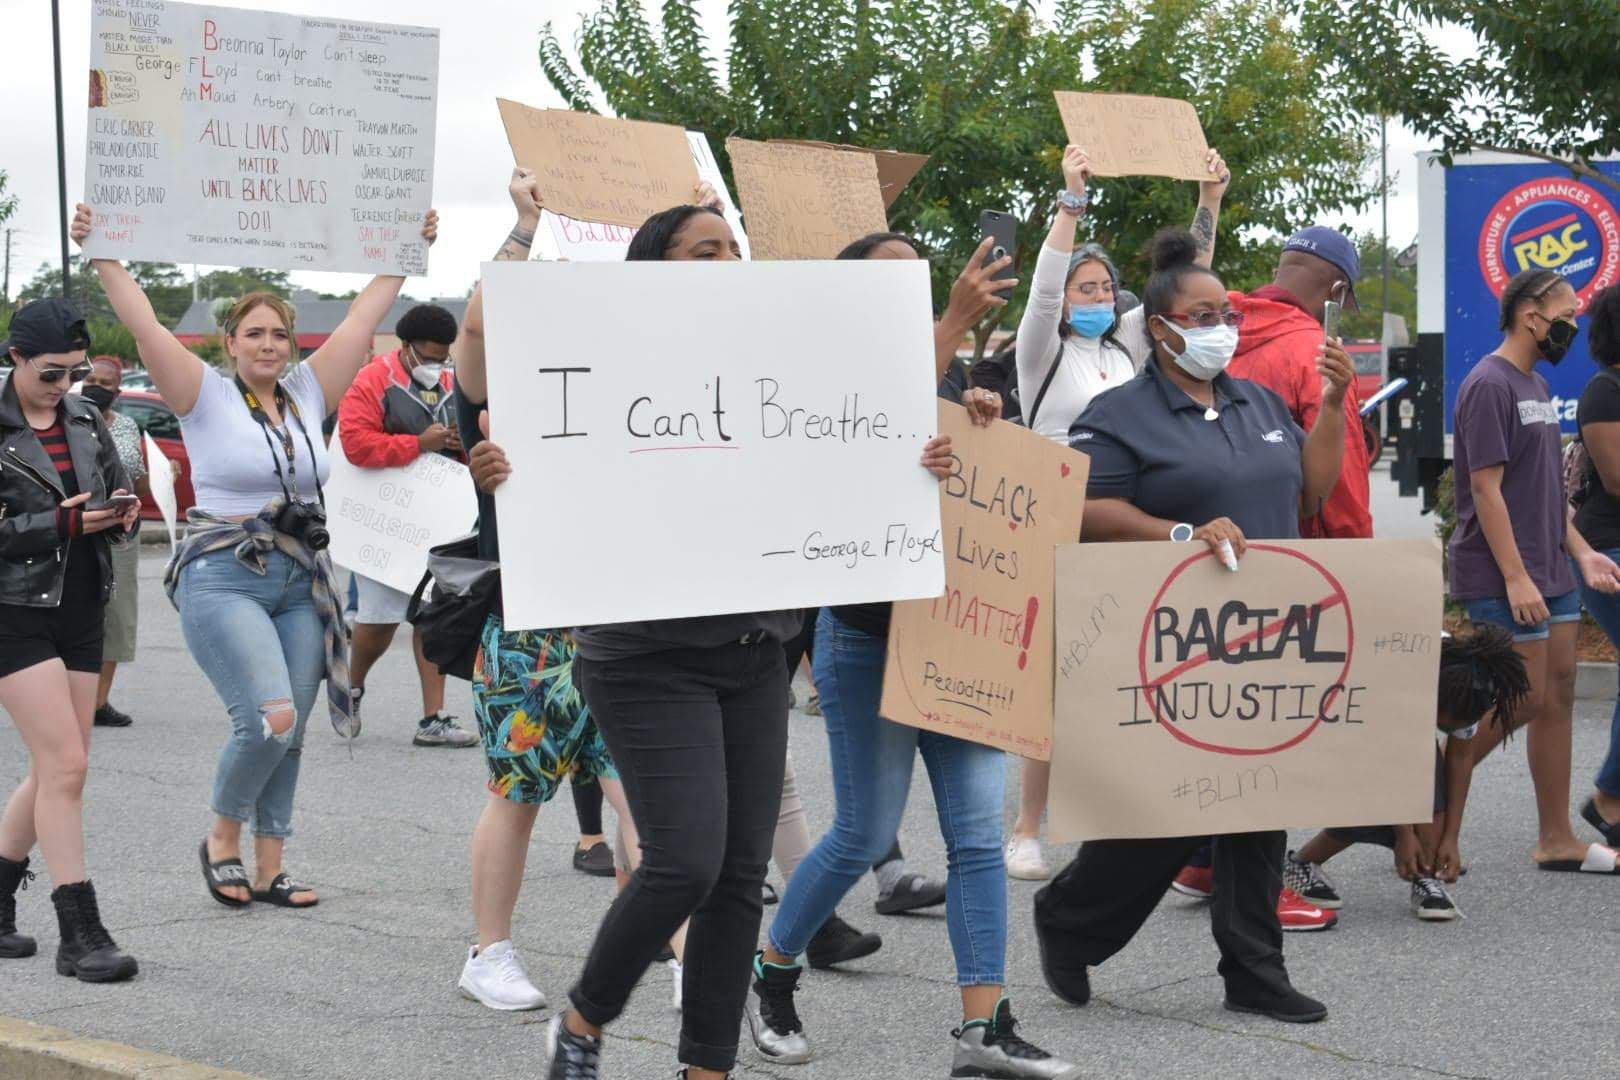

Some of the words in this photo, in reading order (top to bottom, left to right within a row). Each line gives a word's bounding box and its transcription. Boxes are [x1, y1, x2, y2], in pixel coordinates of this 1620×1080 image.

[97, 7, 127, 18] SHOULD
[128, 11, 160, 28] NEVER
[104, 41, 131, 52] BLACK
[203, 19, 264, 57] Breonna
[266, 36, 308, 67] Taylor
[358, 49, 388, 66] sleep
[135, 56, 181, 80] George
[293, 73, 334, 90] breathe
[252, 92, 297, 117] Arbery
[94, 117, 118, 135] ERIC
[120, 118, 155, 138] GARNER
[199, 119, 238, 148] ALL
[244, 122, 289, 155] LIVES
[238, 156, 280, 175] MATTER
[352, 142, 381, 159] WALTER
[384, 145, 414, 161] SCOTT
[96, 164, 125, 178] TAMIR
[126, 164, 145, 179] RICE
[91, 183, 132, 206] SANDRA
[134, 184, 167, 207] BLAND
[201, 178, 234, 199] UNTIL
[241, 177, 286, 205] BLACK
[287, 178, 328, 205] LIVES
[355, 184, 383, 200] OSCAR
[384, 186, 412, 201] GRANT
[1514, 183, 1592, 206] APPLIANCES
[1485, 213, 1507, 283] FURNITURE
[1513, 222, 1588, 272] RAC
[1593, 210, 1619, 291] ELECTRONICS
[538, 367, 591, 439] I
[627, 375, 732, 442] Can't
[755, 377, 934, 444] Breathe...
[378, 482, 415, 509] NO
[944, 454, 1038, 528] BLACK
[338, 497, 430, 546] JUSTICE
[358, 543, 392, 569] NO
[802, 531, 877, 569] George
[884, 523, 941, 563] Floyd
[955, 526, 1019, 581] Lives
[1060, 592, 1121, 680] #BLM
[1153, 600, 1347, 665] RACIAL
[1372, 632, 1433, 657] #BLM
[1116, 681, 1369, 727] INJUSTICE
[1171, 763, 1280, 812] #BLM
